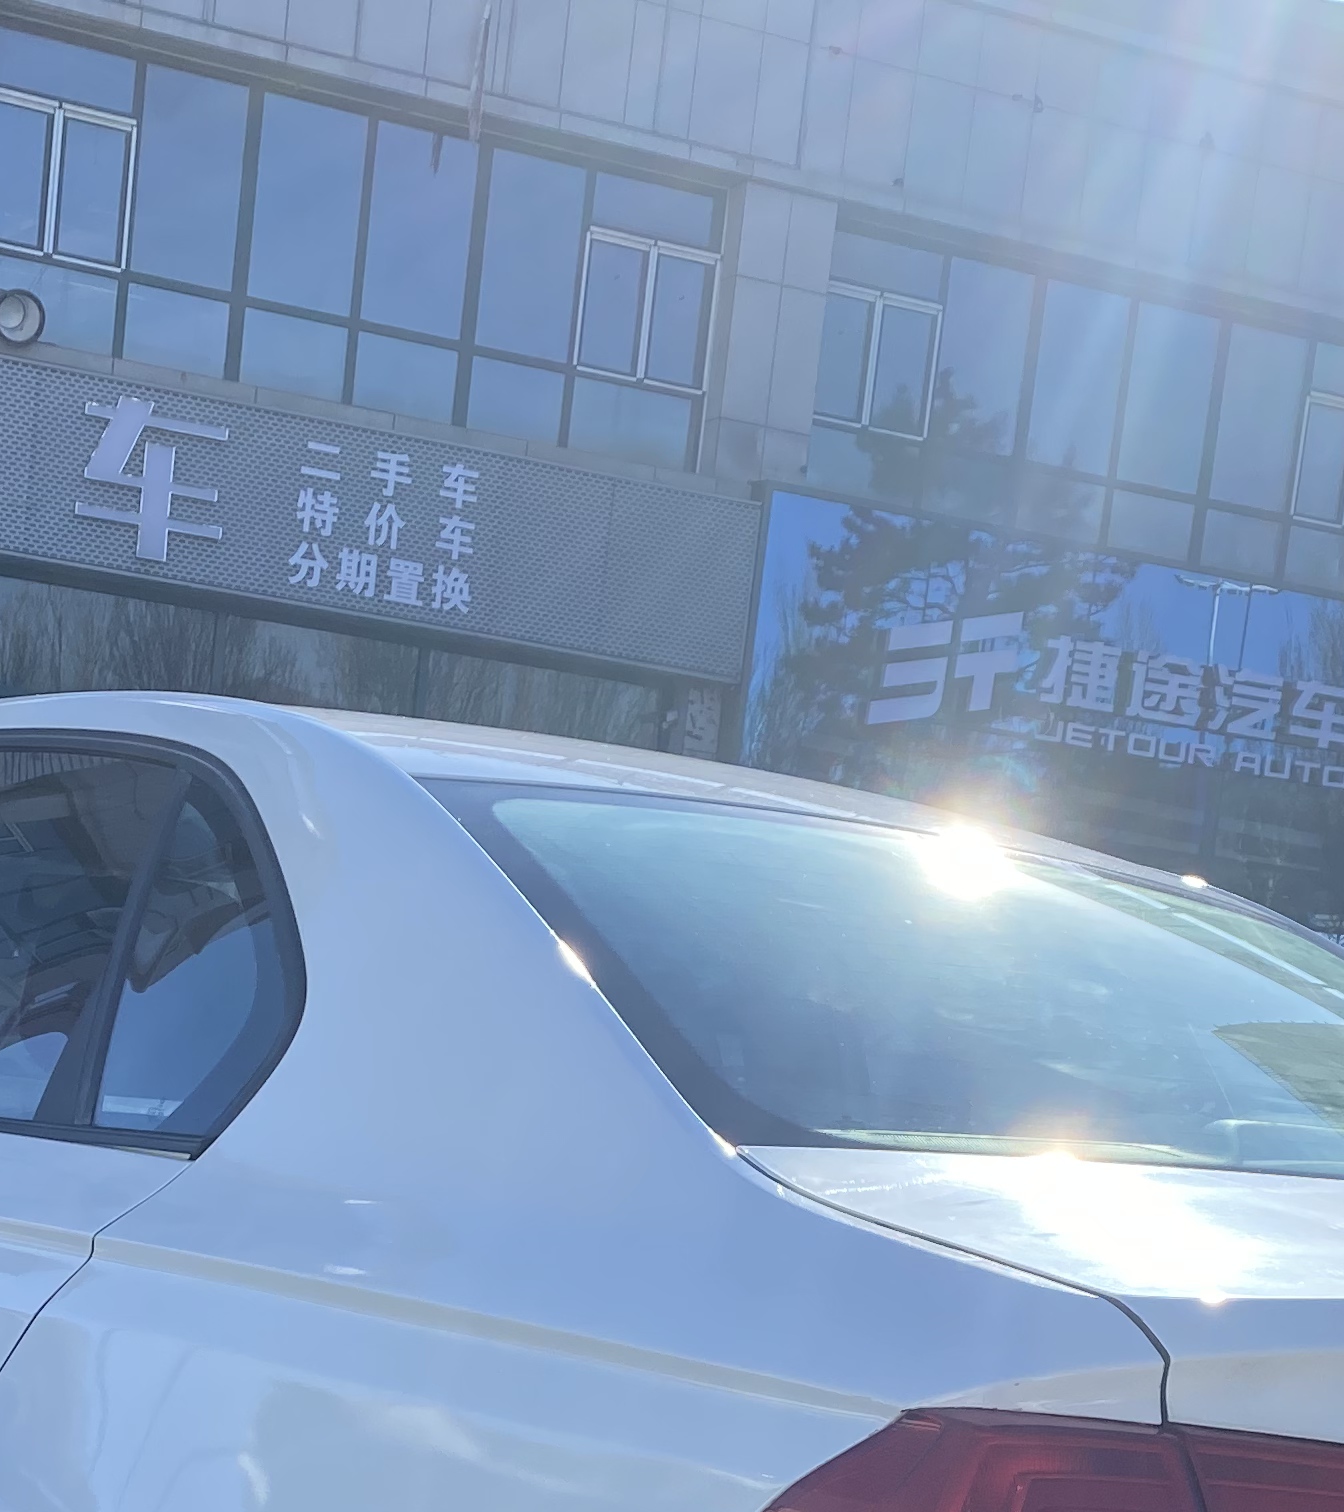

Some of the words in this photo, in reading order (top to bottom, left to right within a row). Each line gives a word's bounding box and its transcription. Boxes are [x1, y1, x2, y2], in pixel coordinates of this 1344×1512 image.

[300, 440, 480, 509] 二手车
[296, 487, 476, 560] 特价车
[288, 540, 472, 614] 分期置换
[1034, 725, 1214, 767] JETOUR
